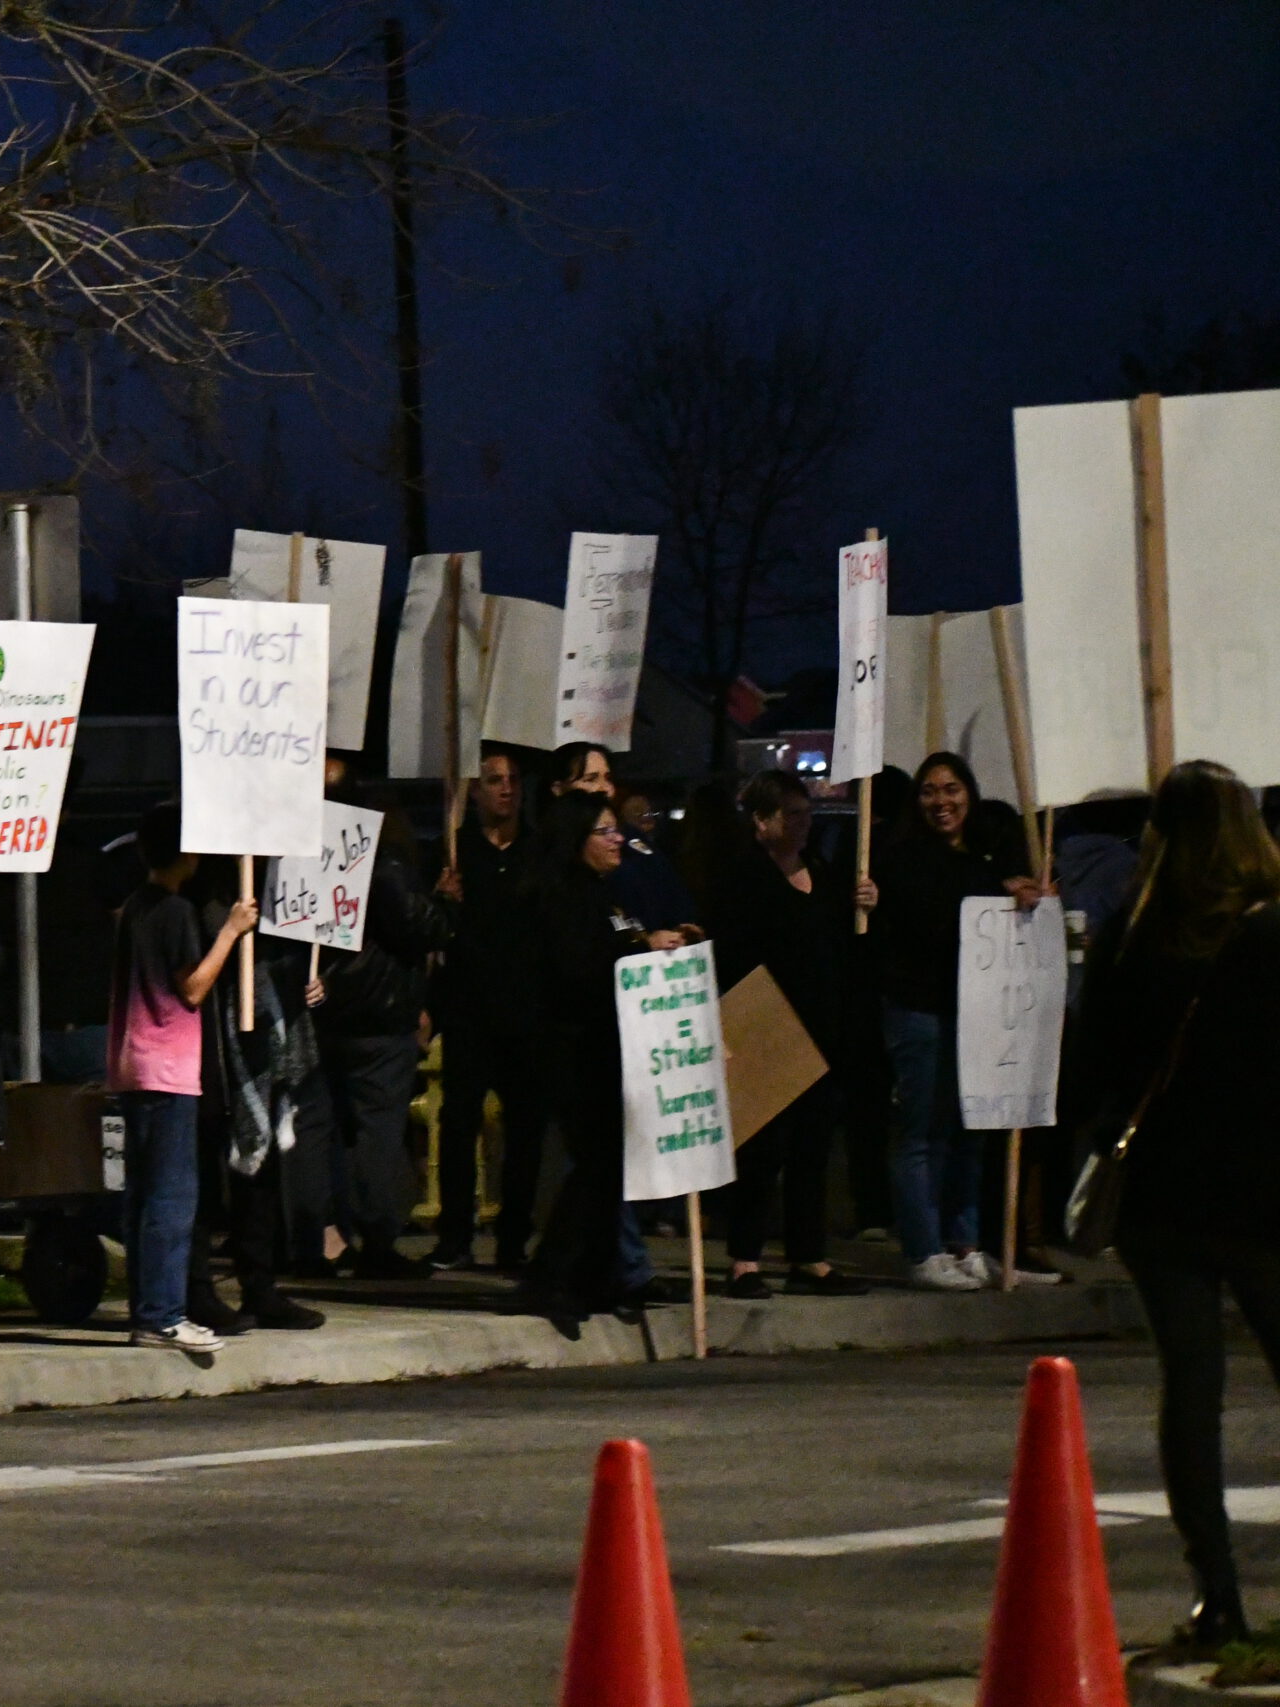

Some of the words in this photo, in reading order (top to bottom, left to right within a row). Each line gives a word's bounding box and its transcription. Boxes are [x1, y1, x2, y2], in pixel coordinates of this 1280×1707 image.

[189, 610, 302, 665] Invest
[338, 823, 371, 872] Job
[272, 876, 318, 926] Hate
